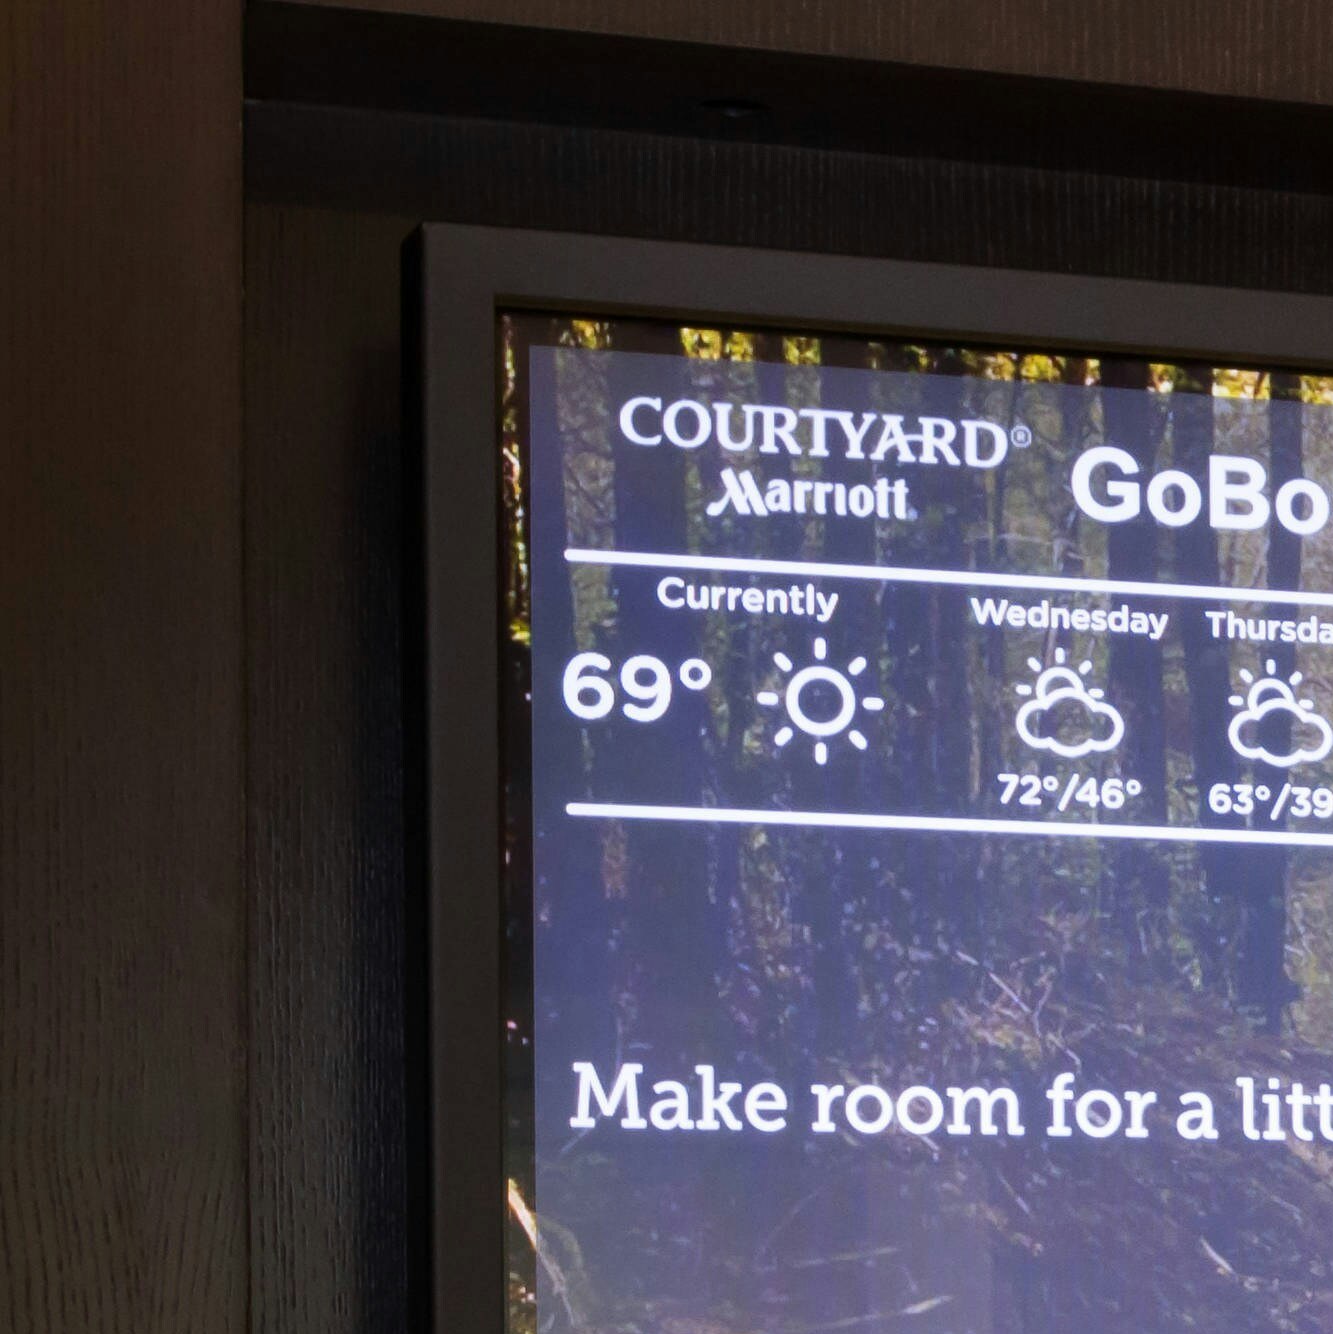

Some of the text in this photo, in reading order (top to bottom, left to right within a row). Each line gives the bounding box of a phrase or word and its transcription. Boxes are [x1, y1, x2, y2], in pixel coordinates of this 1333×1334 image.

[706, 467, 910, 520] Marriott
[656, 577, 839, 623] Currently
[970, 597, 1169, 640] Wednesday
[562, 651, 712, 722] 69°
[997, 773, 1142, 812] 72°/46°
[569, 1061, 788, 1132] Make
[811, 1083, 1026, 1136] room
[1046, 1072, 1157, 1138] for
[1176, 1091, 1219, 1140] a
